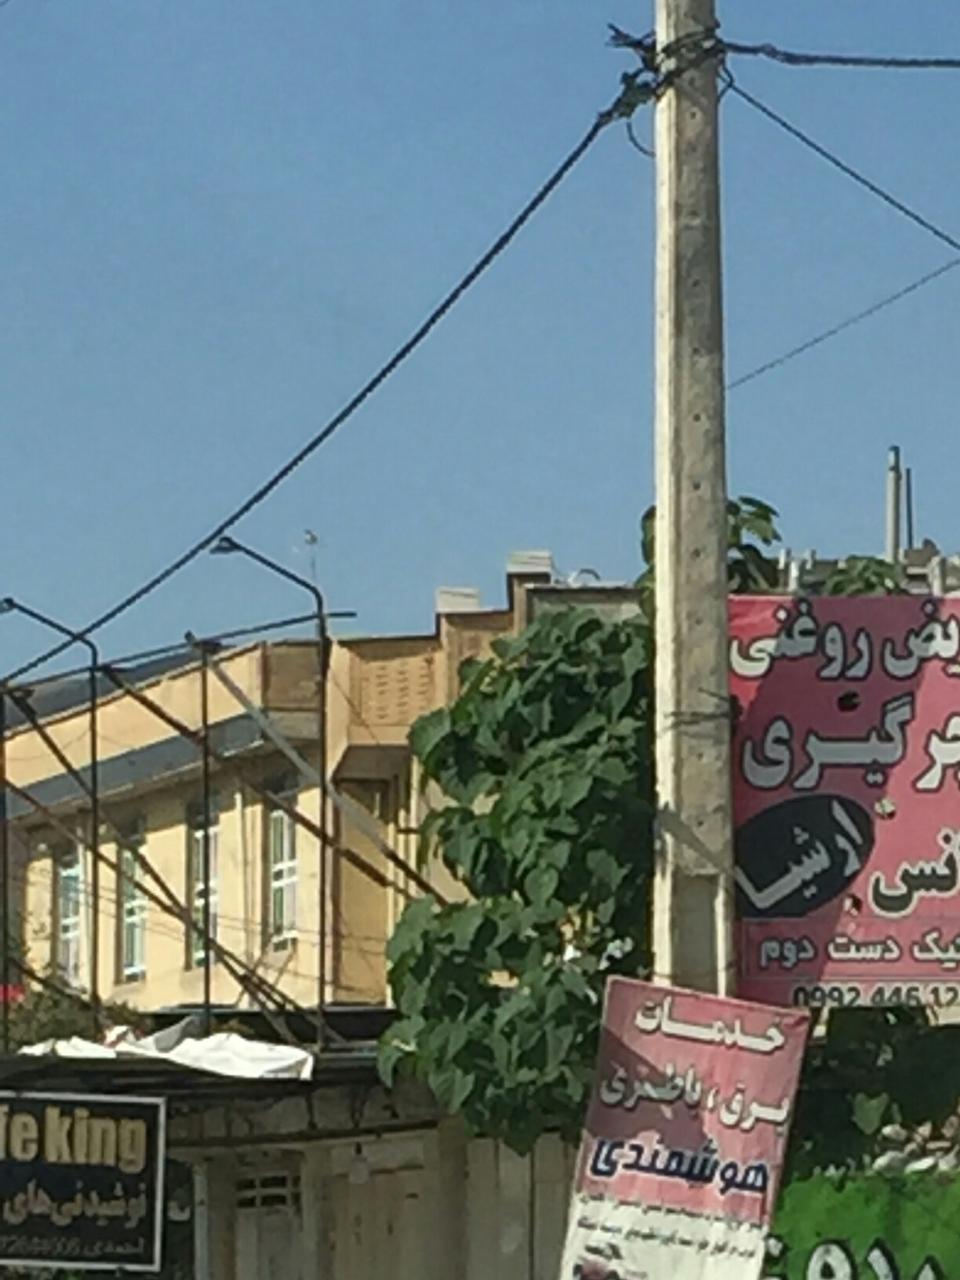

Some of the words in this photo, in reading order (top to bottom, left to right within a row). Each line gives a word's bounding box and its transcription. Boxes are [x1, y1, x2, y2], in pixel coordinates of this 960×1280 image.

[729, 600, 873, 679] روغنی
[742, 691, 913, 790] گیری
[760, 937, 814, 968] دوم
[828, 935, 900, 962] دست
[634, 996, 785, 1052] خدمات
[589, 1136, 769, 1195] هوشمندی
